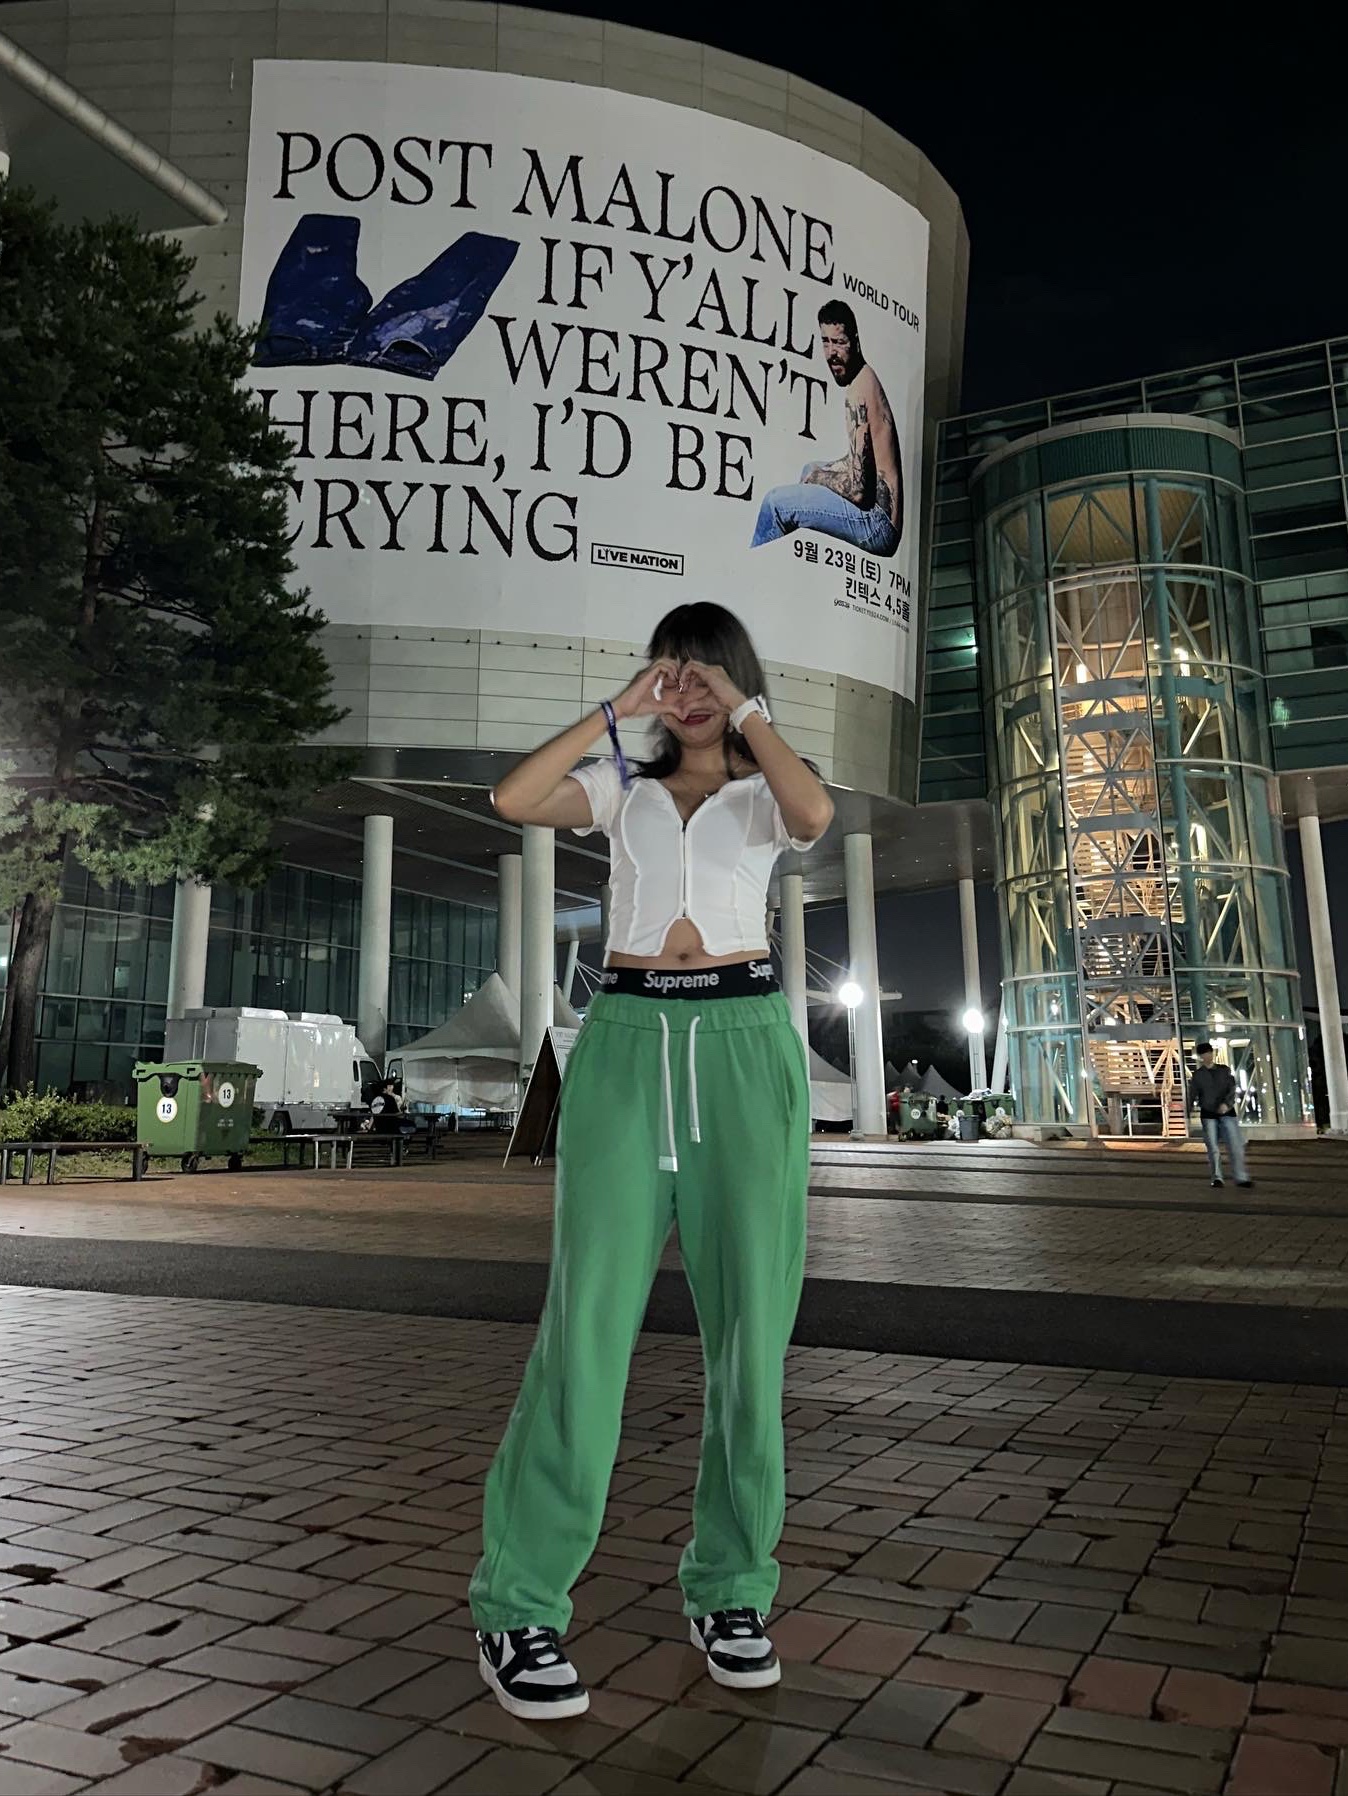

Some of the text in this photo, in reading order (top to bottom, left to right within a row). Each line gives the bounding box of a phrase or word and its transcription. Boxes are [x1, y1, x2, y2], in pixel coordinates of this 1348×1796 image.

[272, 131, 835, 287] POST MALONE
[536, 236, 815, 360] IF Y’ALL
[843, 272, 920, 333] WORLD TOUR
[487, 313, 828, 441] WEREN’T
[256, 388, 754, 502] HERE, I’D BE
[597, 548, 679, 570] LIVE NATION
[794, 540, 910, 597] 9월 23일 (토) 7PM
[845, 577, 909, 622] 킨텍스 4,5홀
[643, 970, 720, 994] Supreme
[162, 1104, 172, 1114] 13
[223, 1089, 231, 1099] 13
